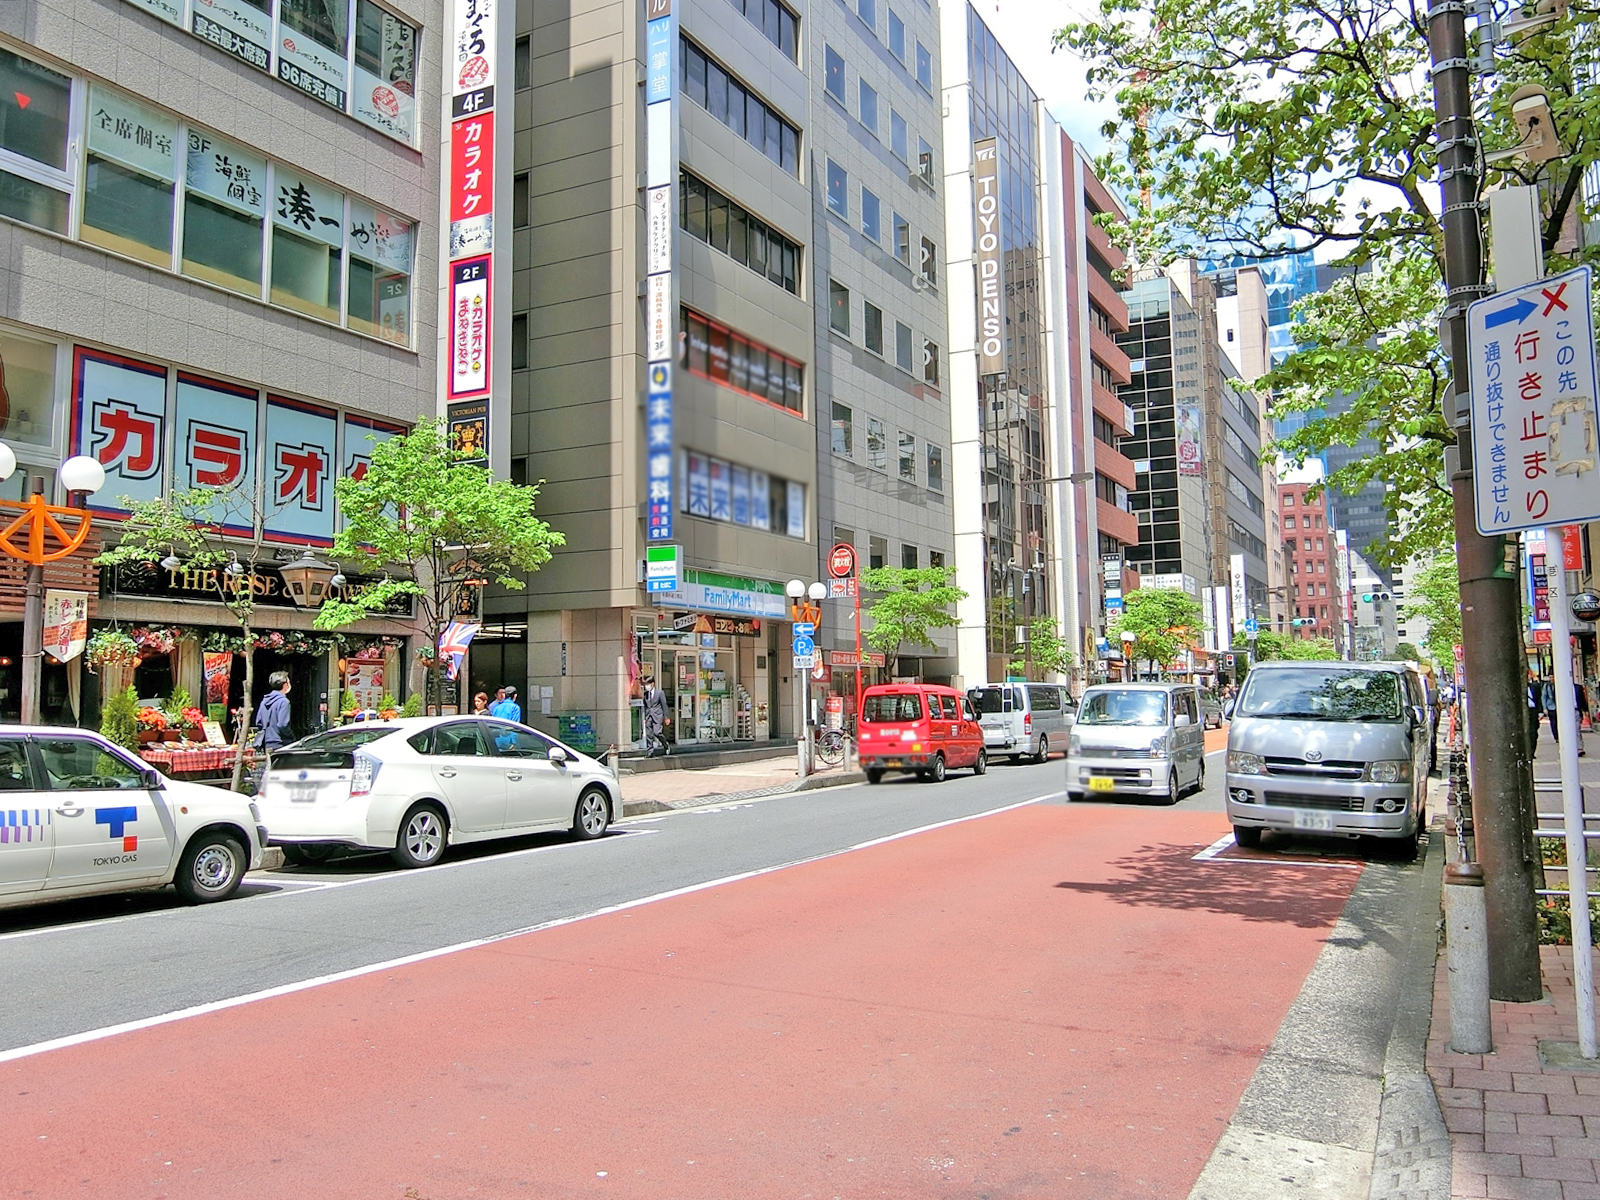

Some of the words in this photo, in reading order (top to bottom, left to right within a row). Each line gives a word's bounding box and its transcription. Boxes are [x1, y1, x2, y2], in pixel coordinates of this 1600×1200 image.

[195, 15, 268, 69] 宴会最大席数
[652, 39, 667, 94] 一掌堂
[463, 92, 484, 112] 4F
[95, 107, 173, 159] 全席個室
[188, 131, 212, 154] 3F
[463, 122, 482, 215] カラオケ
[978, 175, 997, 252] TOYO
[463, 267, 479, 281] 2F
[981, 259, 1002, 357] DENSO
[472, 307, 483, 361] カラオケ
[1556, 320, 1578, 394] この先
[452, 407, 479, 417] VICTORIAN
[1513, 329, 1550, 520] 行き止まり
[1484, 340, 1511, 524] 通り抜けできません
[652, 528, 668, 538] 空間
[168, 567, 217, 592] THE
[704, 587, 752, 610] FamilyMart
[76, 599, 85, 619] 新橋
[797, 641, 806, 655] P
[93, 855, 120, 867] TOKYO
[121, 854, 138, 864] GAS
